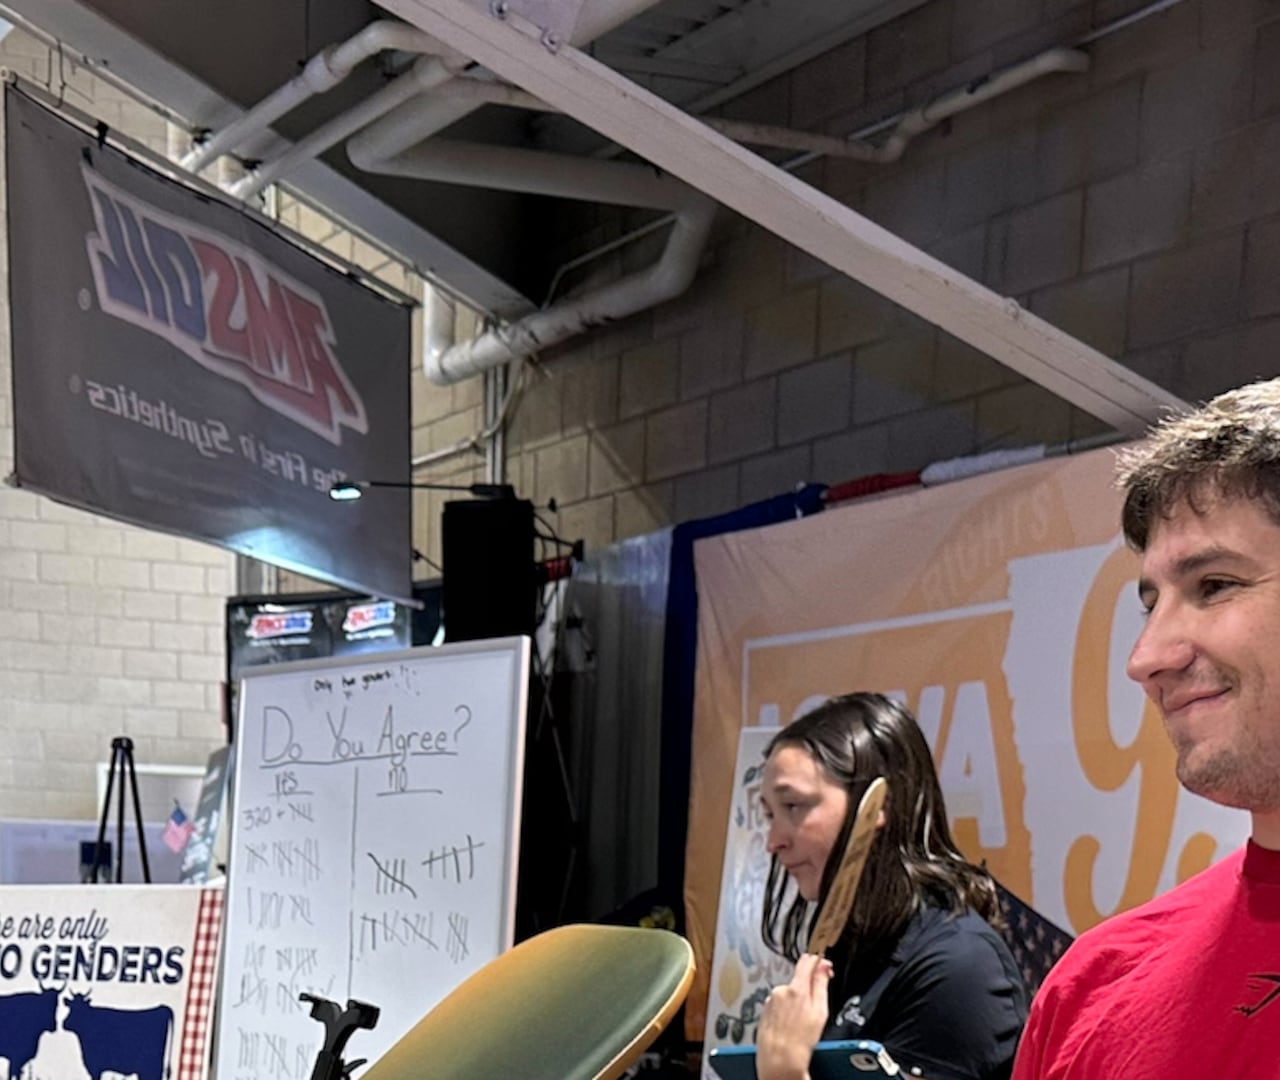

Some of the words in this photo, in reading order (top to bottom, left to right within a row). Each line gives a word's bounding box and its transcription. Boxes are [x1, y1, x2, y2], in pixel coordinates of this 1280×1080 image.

[263, 705, 303, 765] Do
[326, 705, 365, 762] You
[377, 703, 472, 767] Agree?
[17, 916, 57, 939] are
[59, 908, 108, 950] only
[31, 944, 185, 985] GENDERS
